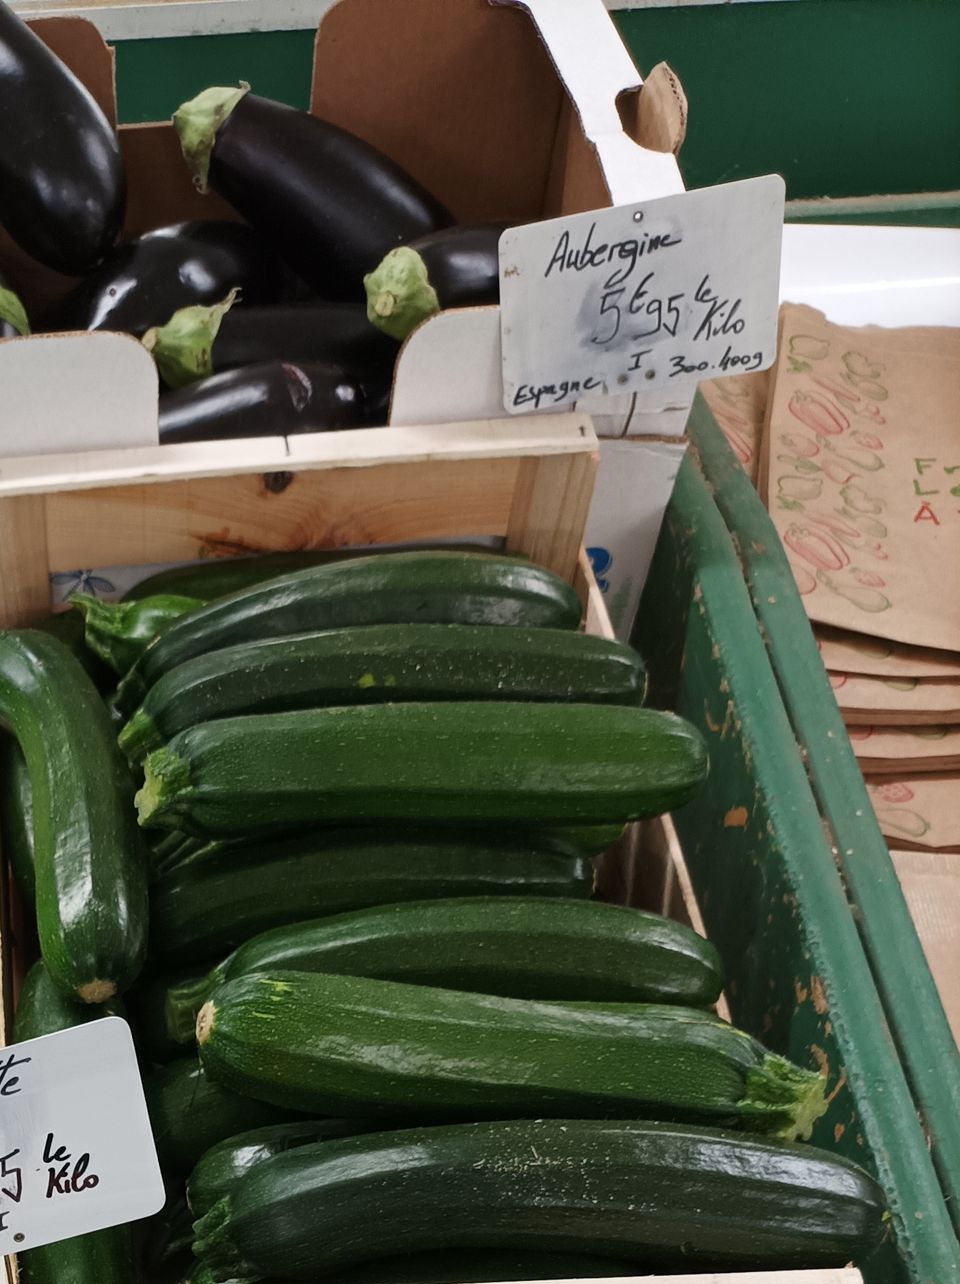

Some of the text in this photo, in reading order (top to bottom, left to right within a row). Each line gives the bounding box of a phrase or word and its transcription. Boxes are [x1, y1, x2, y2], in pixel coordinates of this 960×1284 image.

[544, 222, 682, 289] Aubergine
[694, 274, 717, 303] le
[692, 298, 745, 341] Kilo
[512, 376, 602, 408] Espagne
[43, 1133, 72, 1163] le
[46, 1152, 100, 1199] Kilo
